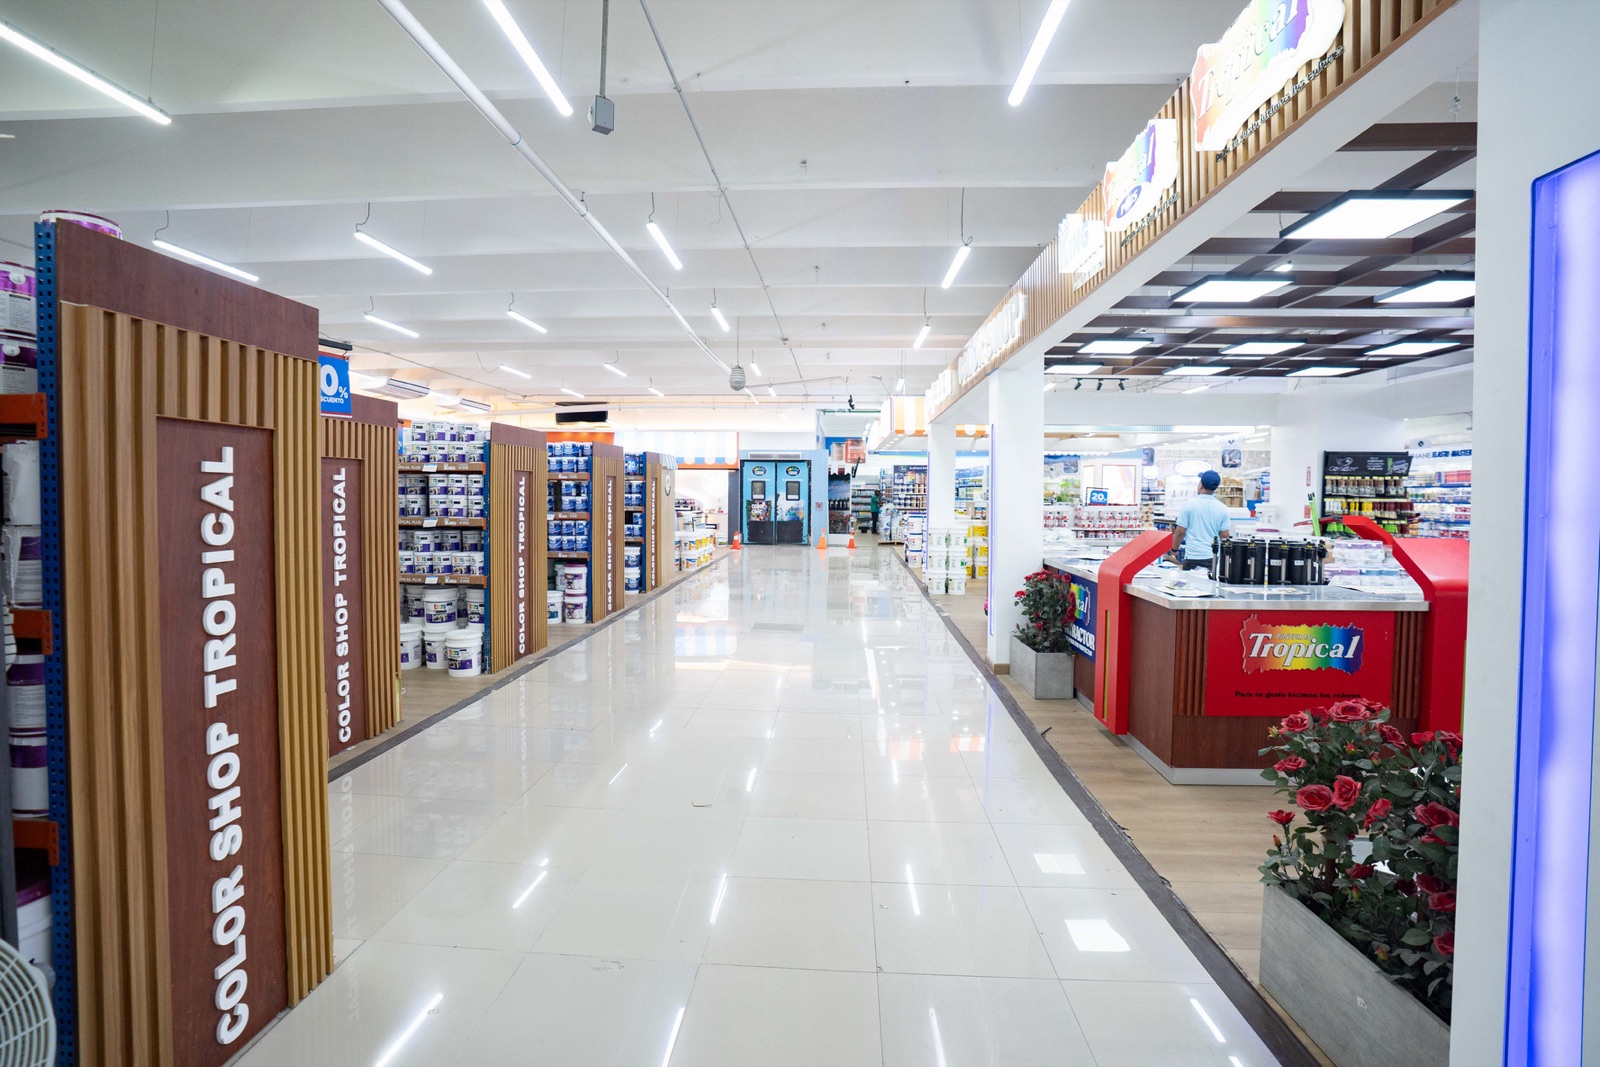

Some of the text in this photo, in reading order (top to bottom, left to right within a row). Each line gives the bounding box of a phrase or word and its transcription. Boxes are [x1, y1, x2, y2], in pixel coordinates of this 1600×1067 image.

[332, 468, 351, 743] COLOR SHOP TROPICAL
[518, 601, 526, 654] COLOR
[1249, 633, 1360, 666] Tropical
[1265, 691, 1286, 699] gusto
[201, 446, 249, 1045] COLOR SHOP TROPICAL
